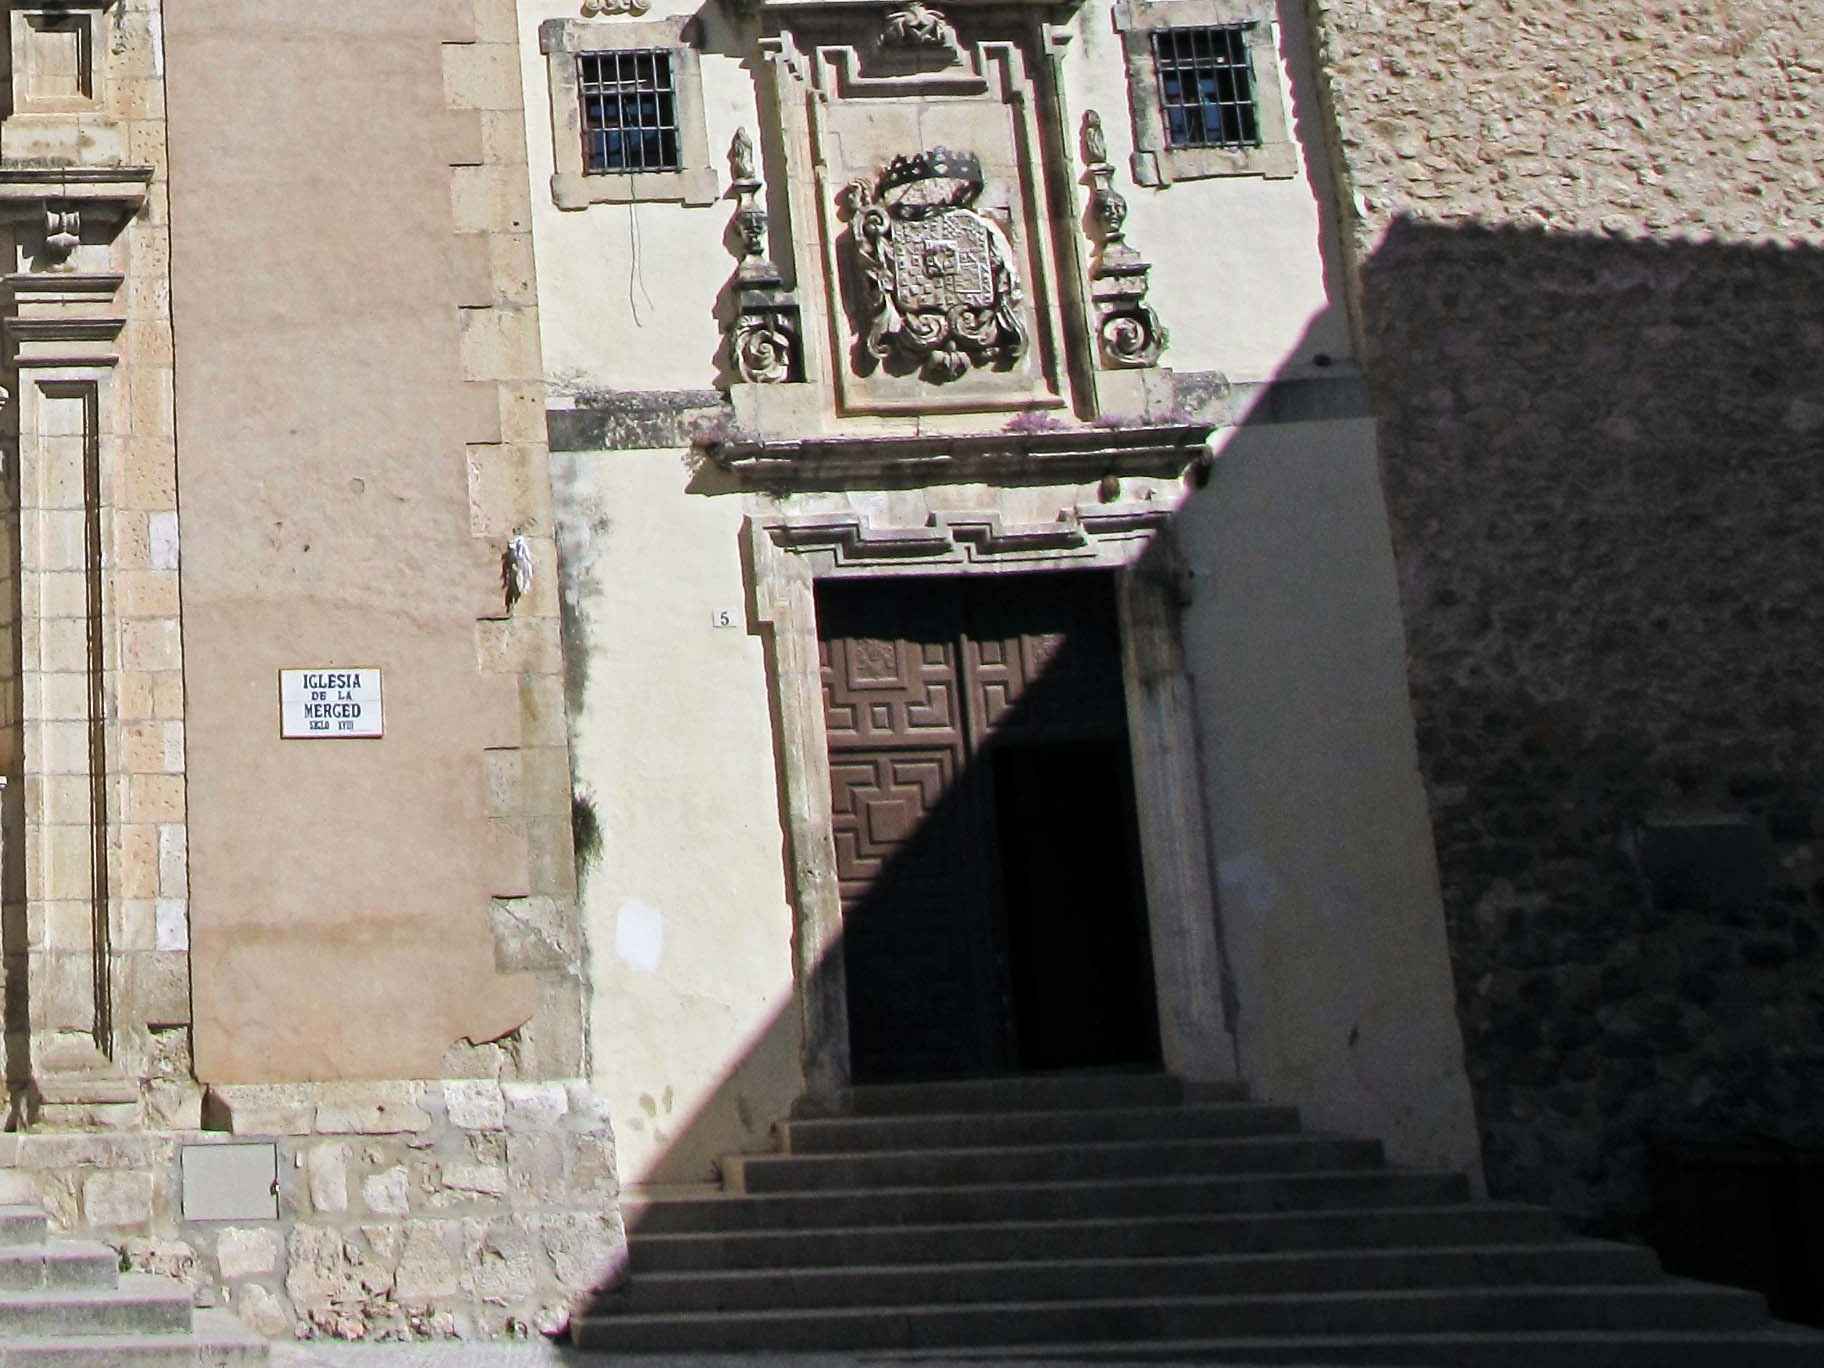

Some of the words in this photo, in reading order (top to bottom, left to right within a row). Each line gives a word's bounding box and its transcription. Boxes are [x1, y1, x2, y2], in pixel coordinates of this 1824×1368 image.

[720, 611, 729, 626] 5
[303, 673, 361, 689] IGLESIA
[311, 691, 327, 701] DE
[337, 690, 353, 701] LA
[309, 720, 330, 730] SIGLO
